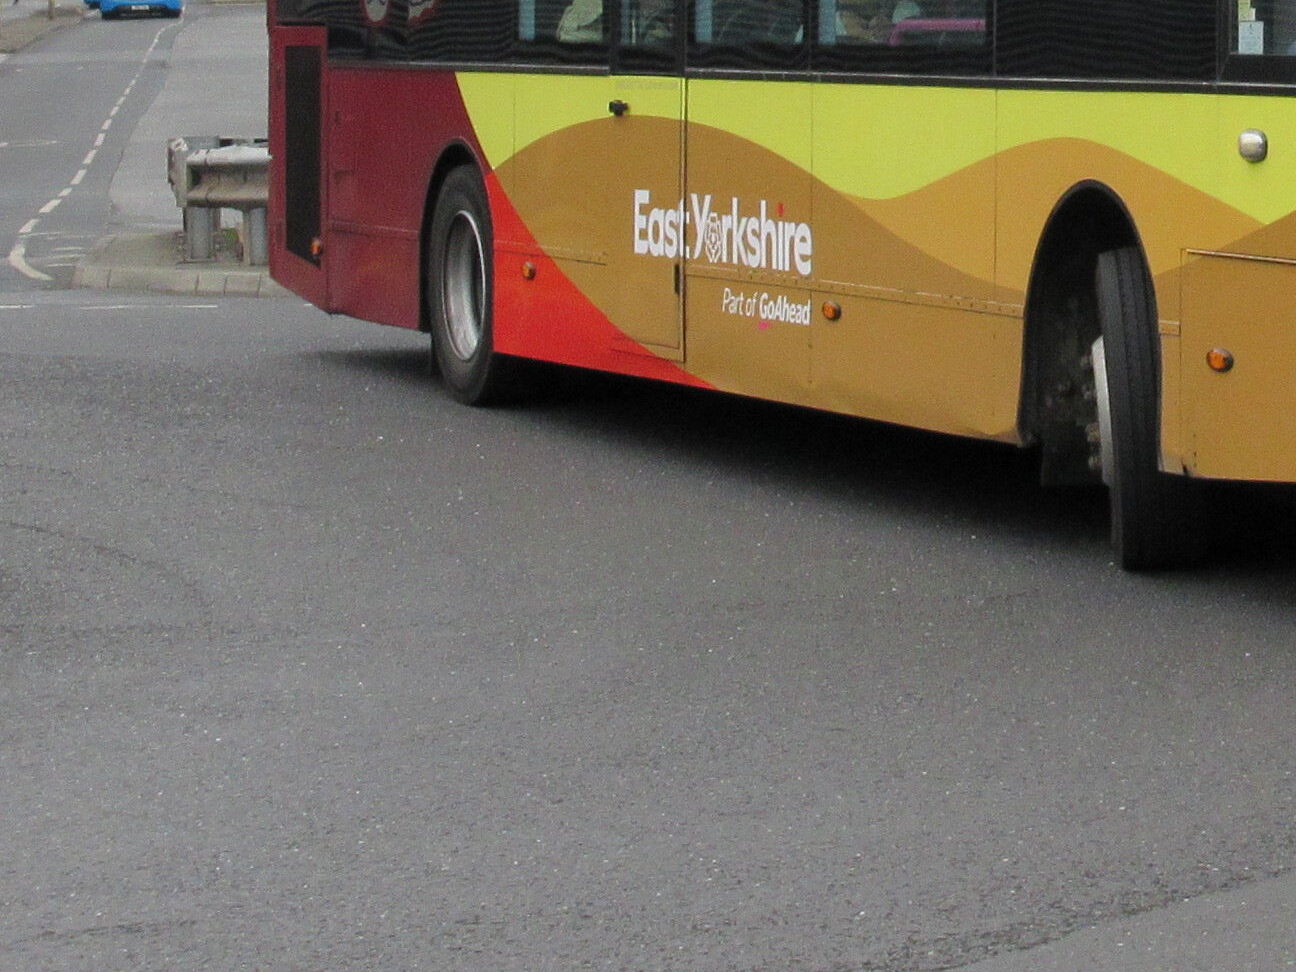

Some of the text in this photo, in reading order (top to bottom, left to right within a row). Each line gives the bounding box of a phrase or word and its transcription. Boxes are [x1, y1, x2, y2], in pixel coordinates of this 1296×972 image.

[633, 188, 690, 259] East
[722, 287, 812, 326] Part of GoAhead
